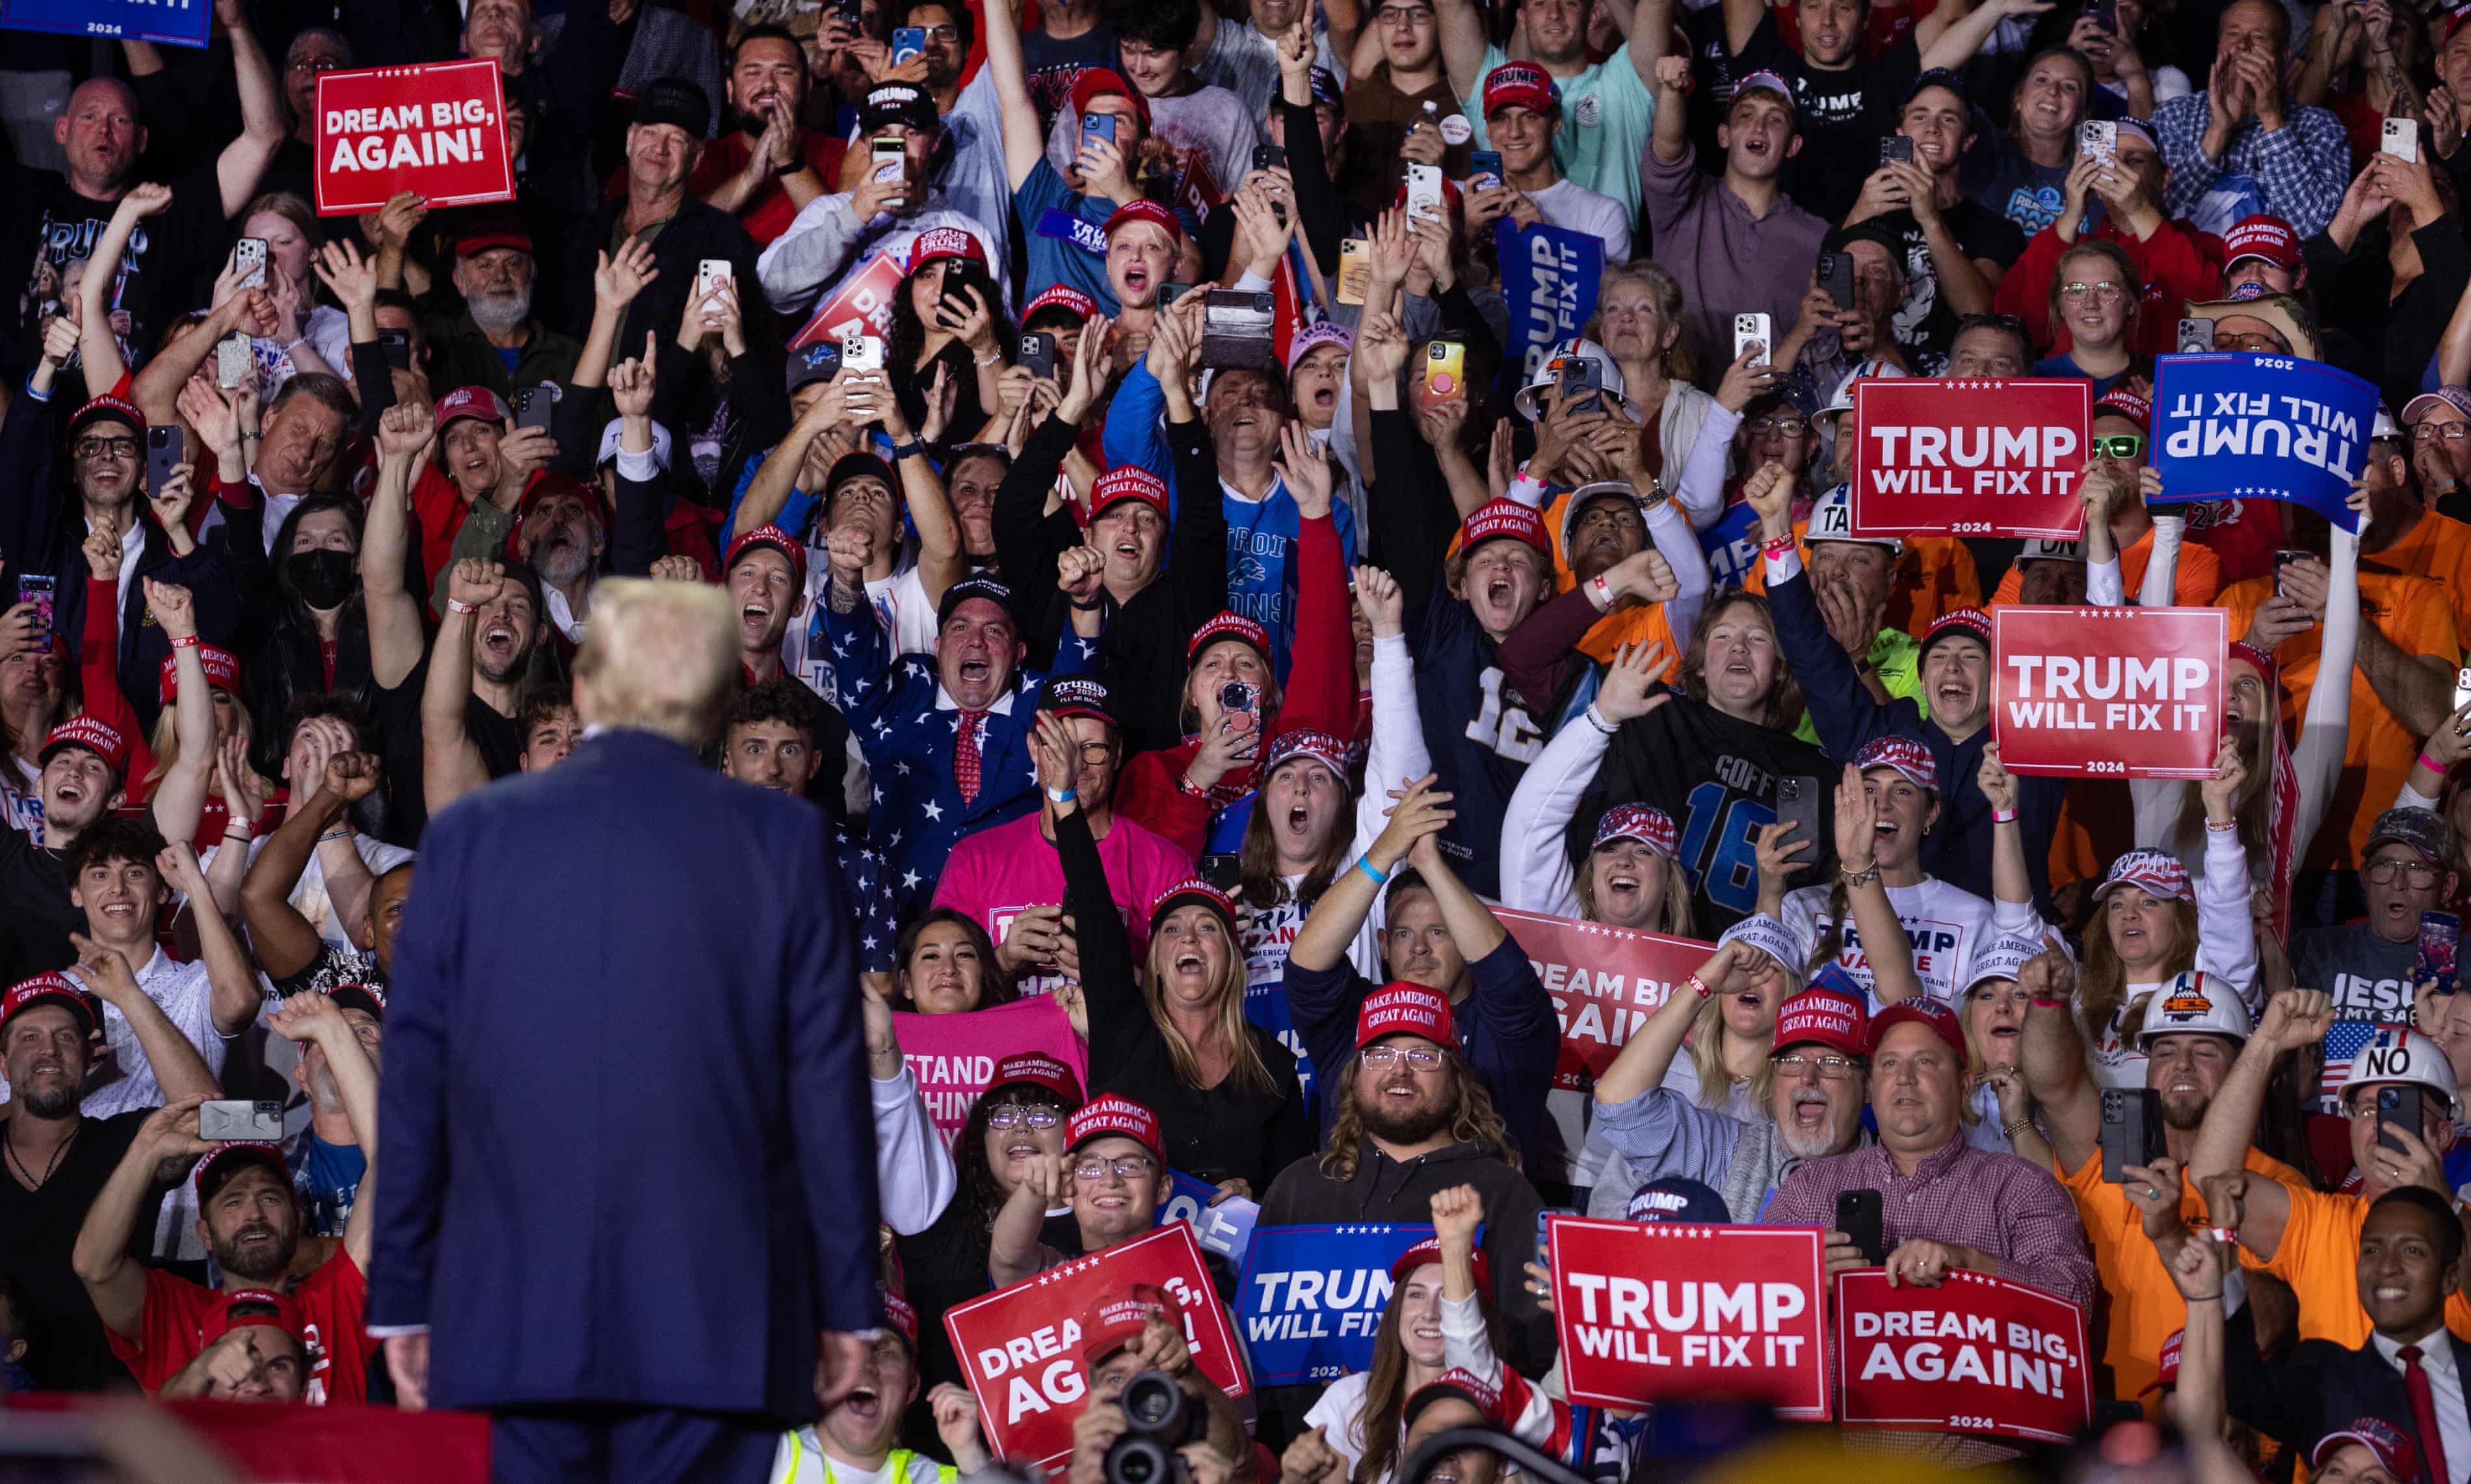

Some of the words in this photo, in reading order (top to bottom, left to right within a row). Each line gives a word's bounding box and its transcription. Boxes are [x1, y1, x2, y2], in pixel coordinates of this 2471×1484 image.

[87, 22, 122, 35] 2024
[867, 86, 918, 105] TRUMP
[326, 104, 423, 135] DREAM
[432, 99, 495, 127] BIG,
[330, 128, 484, 174] AGAIN!
[2225, 225, 2246, 244] MAKE
[2246, 223, 2289, 240] AMERICA
[2230, 235, 2254, 250] GREAT
[2254, 234, 2284, 248] AGAIN
[1559, 242, 1579, 274] IT
[1050, 288, 1091, 307] AMERICA
[1559, 281, 1578, 331] FIX
[1522, 234, 1559, 390] RUMP
[1298, 323, 1349, 344] TRUMP
[2254, 357, 2295, 371] 2024
[2108, 391, 2150, 413] AMERICA
[2170, 392, 2202, 418] IT
[2213, 391, 2270, 416] FIX
[2281, 396, 2358, 444] WILL
[1871, 427, 2077, 468] TRUMP
[2165, 418, 2355, 484] TRUMP
[1096, 473, 1123, 488] MAKE
[1123, 468, 1166, 493] AMERICA
[1100, 481, 1129, 499] GREAT
[1131, 483, 1160, 500] AGAIN
[1871, 470, 1962, 496] WILL
[1974, 470, 2030, 496] FIX
[2041, 471, 2076, 496] IT
[1467, 507, 1493, 526] MAKE
[1492, 505, 1538, 524] AMERICA
[1471, 520, 1501, 537] GREAT
[1501, 518, 1533, 537] AGAIN
[1823, 505, 1849, 531] TA
[1951, 522, 1992, 534] 2024
[1779, 533, 1793, 544] VIP
[1194, 622, 1216, 640] MAKE
[1216, 615, 1263, 635] AMERICA
[1957, 609, 1992, 626] AMERI
[172, 639, 187, 647] VIP
[200, 649, 235, 667] MERICA
[2007, 656, 2211, 700] TRUMP
[2008, 701, 2096, 730] WILL
[2106, 703, 2163, 730] FIX
[2173, 704, 2208, 732] IT
[77, 717, 122, 745] AMERICA
[83, 728, 116, 753] AGAIN
[1715, 754, 1774, 797] GOFF
[2087, 761, 2126, 773] 2024
[1603, 806, 1676, 832] TRUMP
[1680, 780, 1778, 913] 16
[1182, 879, 1230, 903] AMERICA
[1728, 920, 1754, 936] MAKE
[1754, 918, 1797, 943] AMERICA
[1817, 924, 1955, 952] TRMP
[1762, 935, 1790, 955] AGAIN
[1975, 943, 1998, 960] MAKE
[1839, 953, 1931, 972] VAE
[1975, 957, 2002, 975] GREAT
[12, 977, 45, 994] MAKE
[1689, 977, 1704, 991] VIP
[1923, 976, 1949, 990] GAIN!
[2332, 973, 2414, 1010] JESU
[1365, 991, 1392, 1013] MAKE
[1392, 990, 1443, 1013] AMERICA
[1780, 999, 1806, 1020] MAKE
[1805, 997, 1858, 1021] AMERICA
[1368, 1009, 1401, 1028] GREAT
[1401, 1008, 1436, 1027] AGAIN
[1782, 1015, 1814, 1035] GREAT
[1815, 1014, 1851, 1036] AGAIN
[2344, 1009, 2372, 1022] MY
[902, 1054, 995, 1085] STAND
[1002, 1061, 1028, 1072] MAKE
[1027, 1059, 1064, 1073] AMERICA
[1031, 1068, 1061, 1080] AGAIN
[2365, 1048, 2411, 1078] NO
[1070, 1104, 1099, 1126] MAKE
[1100, 1101, 1152, 1124] AMERICA
[1075, 1115, 1109, 1137] GREAT
[1111, 1115, 1146, 1135] AGAIN
[1629, 1191, 1689, 1216] TRUMP
[1254, 1268, 1397, 1313] TRUM
[1568, 1273, 1806, 1333] TRUMP
[1248, 1312, 1328, 1342] WILL
[1855, 1311, 1997, 1344] DREAM
[2009, 1323, 2078, 1368] BIG,
[978, 1318, 1083, 1381] DREA
[1575, 1325, 1671, 1366] WILL
[1689, 1335, 1752, 1367] FIX
[1765, 1336, 1804, 1367] IT
[1860, 1342, 2066, 1399] AGAIN!
[1949, 1416, 1994, 1429] 2024
